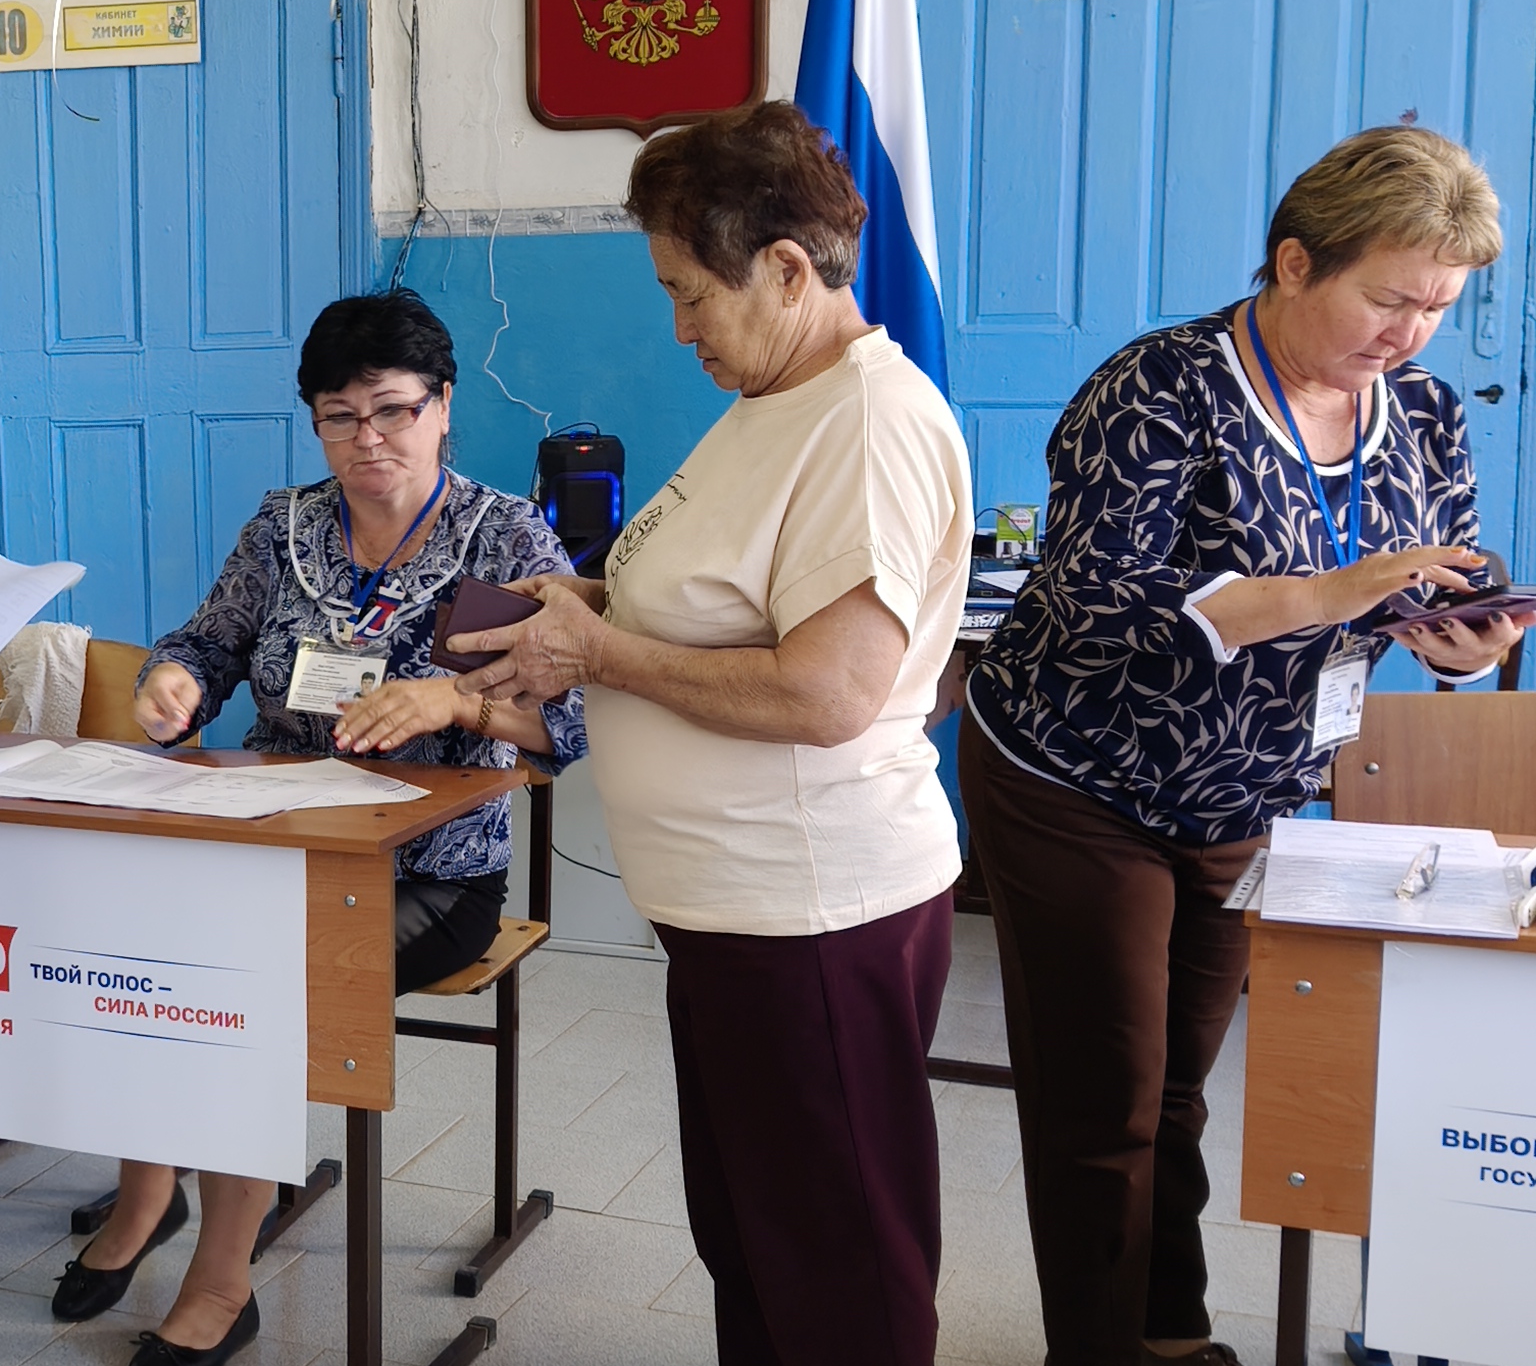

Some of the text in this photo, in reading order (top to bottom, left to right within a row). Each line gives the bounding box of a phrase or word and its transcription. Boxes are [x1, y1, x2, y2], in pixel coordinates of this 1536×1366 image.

[95, 9, 138, 20] КАБИНЕТ
[92, 24, 144, 40] ХИМИИ
[30, 962, 82, 985] ТВОЙ
[87, 970, 153, 993] ГОЛОС
[93, 995, 245, 1030] СИЛА РОССИИ!
[1441, 1127, 1536, 1158] ВЫБО
